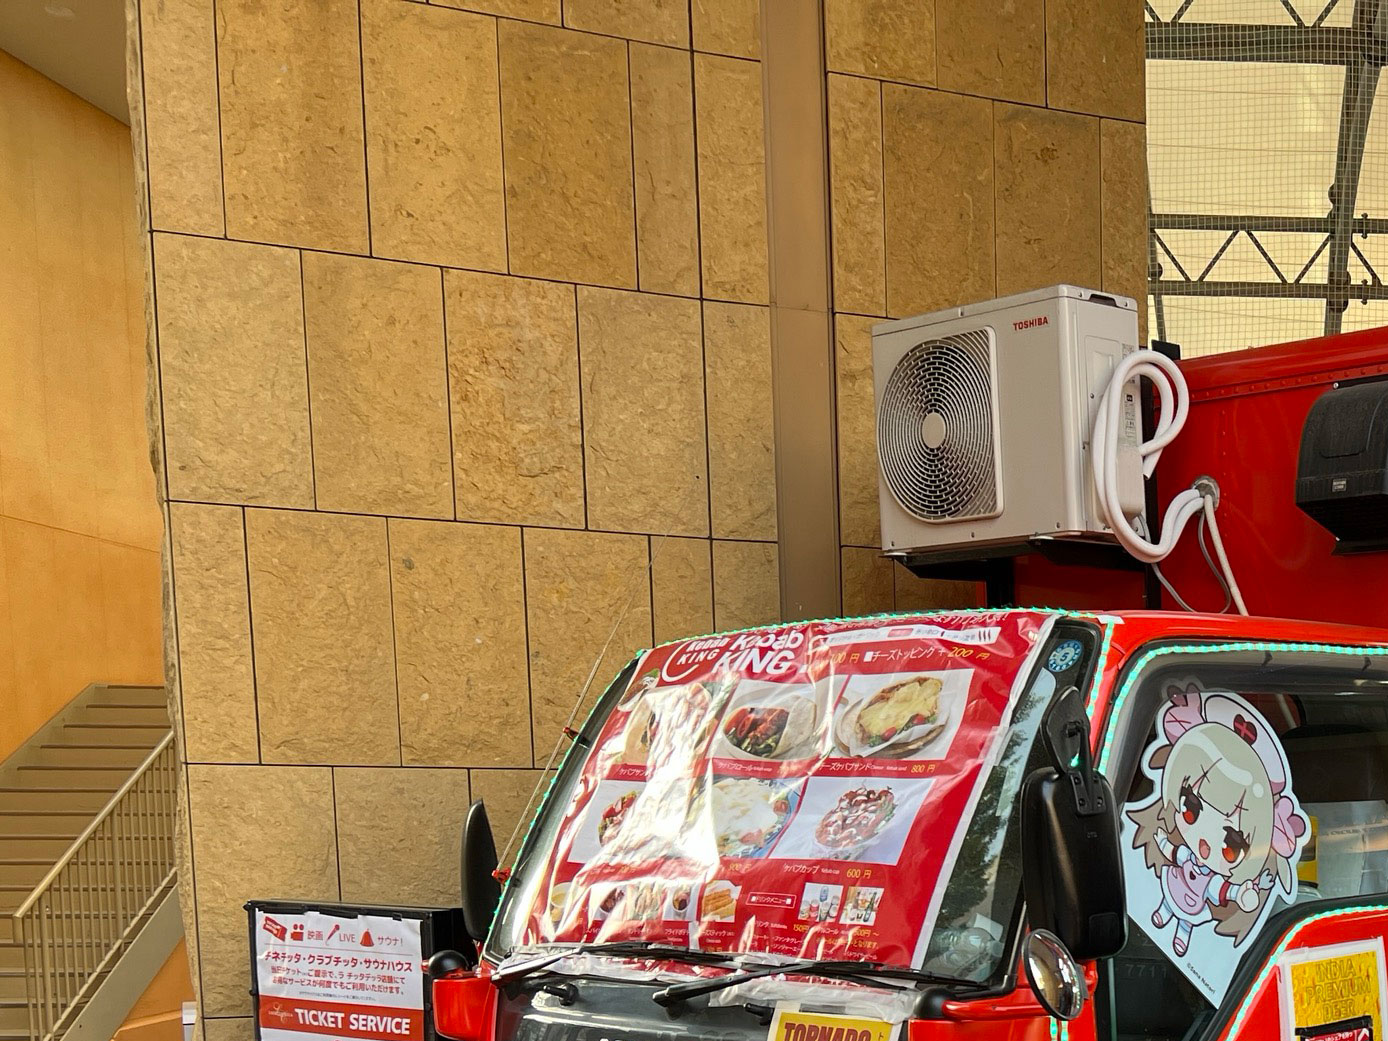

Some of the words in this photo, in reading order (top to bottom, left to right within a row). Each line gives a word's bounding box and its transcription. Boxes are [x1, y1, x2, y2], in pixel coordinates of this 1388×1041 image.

[1012, 316, 1049, 331] TOSHIBA
[677, 649, 720, 665] KING
[947, 646, 974, 658] 200
[711, 649, 796, 675] KING
[783, 864, 820, 875] ケバブカップ
[846, 868, 861, 879] 600
[307, 930, 324, 941] 映画
[339, 931, 356, 943] LIVE
[1315, 958, 1357, 983] INDIA
[1305, 975, 1372, 1006] PREMIUM
[294, 1008, 345, 1029] TICKET
[349, 1013, 411, 1035] SERVICE
